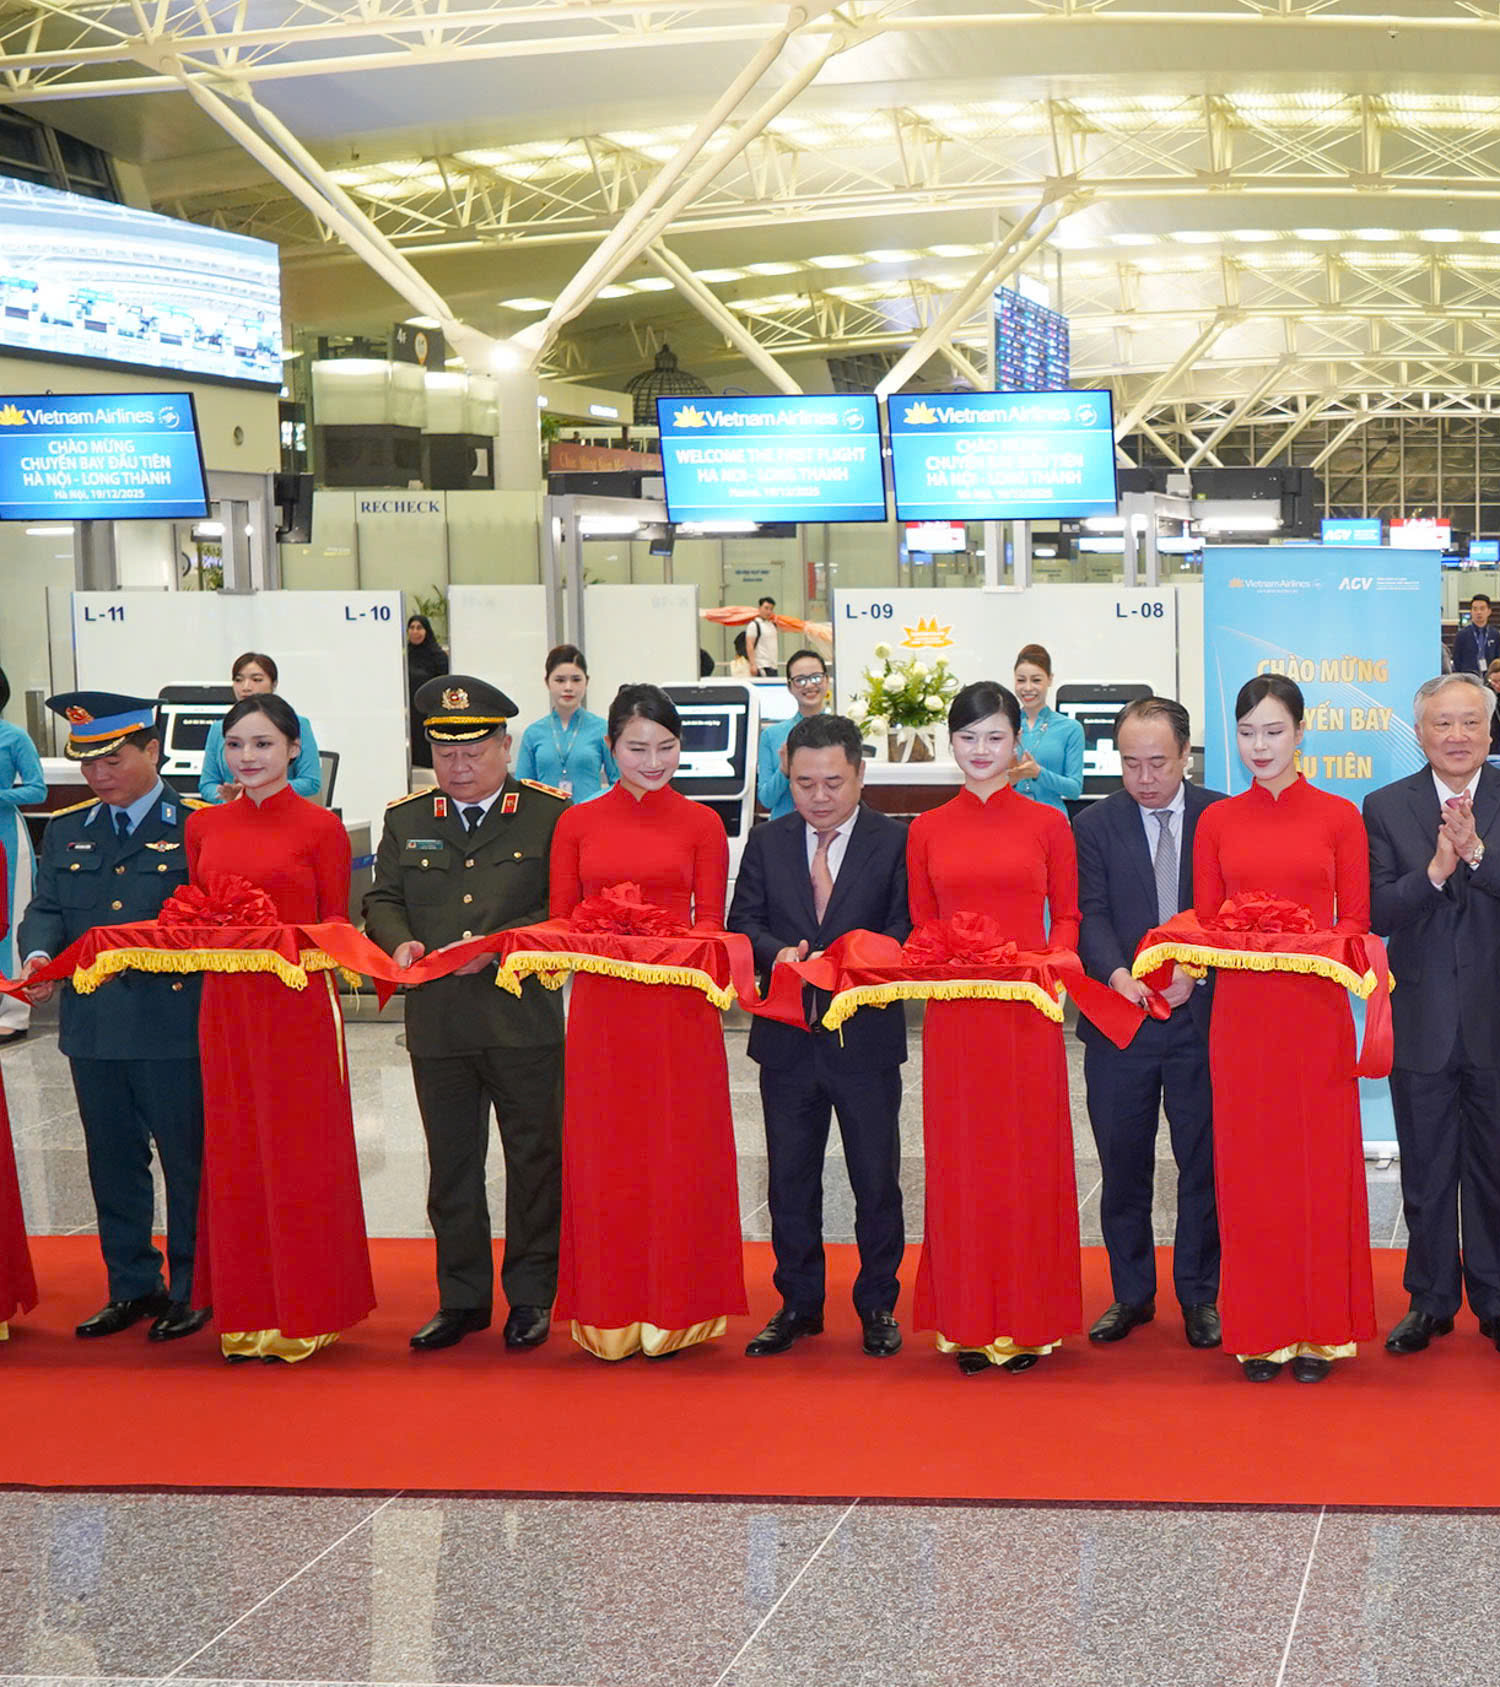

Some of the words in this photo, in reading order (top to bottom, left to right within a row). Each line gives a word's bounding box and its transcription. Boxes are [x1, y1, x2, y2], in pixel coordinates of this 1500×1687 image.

[26, 409, 95, 426] Vietnam
[95, 408, 154, 424] Airlines
[705, 410, 776, 427] Vietnam
[776, 408, 838, 426] Airlines
[936, 407, 1008, 424] Vietnam
[48, 437, 88, 454] CHÀO
[90, 437, 135, 453] MỪNG
[80, 455, 106, 470] BAY
[140, 453, 172, 469] TIÊN
[675, 449, 745, 464] WELCOME
[23, 471, 44, 487] HÀ
[45, 471, 71, 488] NỘI
[81, 472, 120, 486] LONG
[121, 470, 172, 486] THÀNH
[361, 501, 440, 514] RECHECK
[84, 606, 125, 622] L-11
[344, 605, 391, 621] L-10
[846, 603, 893, 619] L-09
[1116, 602, 1164, 618] L-08
[1257, 653, 1315, 682] CHÀO
[1320, 654, 1389, 683] MỪNG
[1350, 707, 1393, 731] BAY
[1323, 751, 1373, 779] TIÊN
